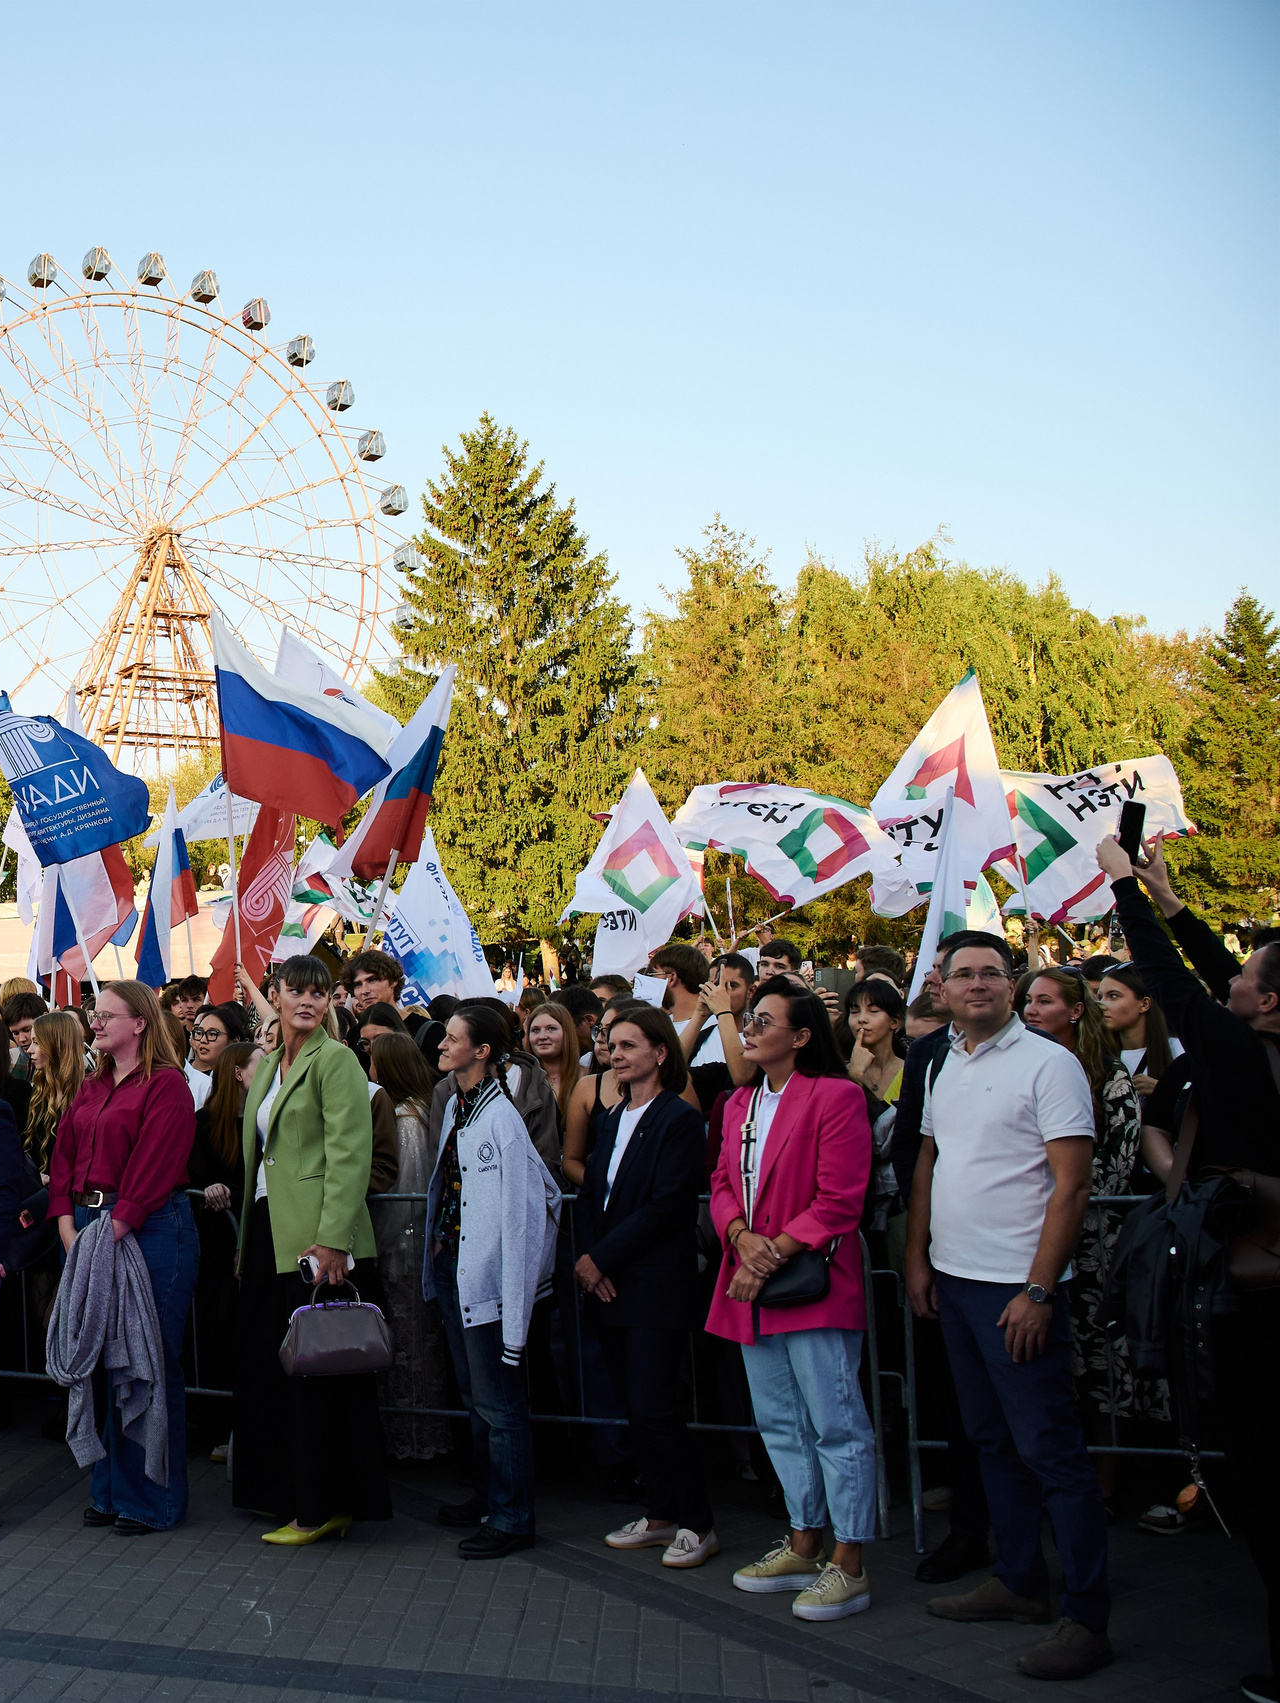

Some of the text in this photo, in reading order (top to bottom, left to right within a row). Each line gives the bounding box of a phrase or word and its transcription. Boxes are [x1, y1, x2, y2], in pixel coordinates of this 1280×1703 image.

[1066, 769, 1146, 822] НЭТИ
[40, 796, 107, 825] ГОСУДАРСТВЕННЫЙ
[77, 806, 110, 822] ДИЗАЙНА
[74, 815, 114, 833] КРЯЧКОВА
